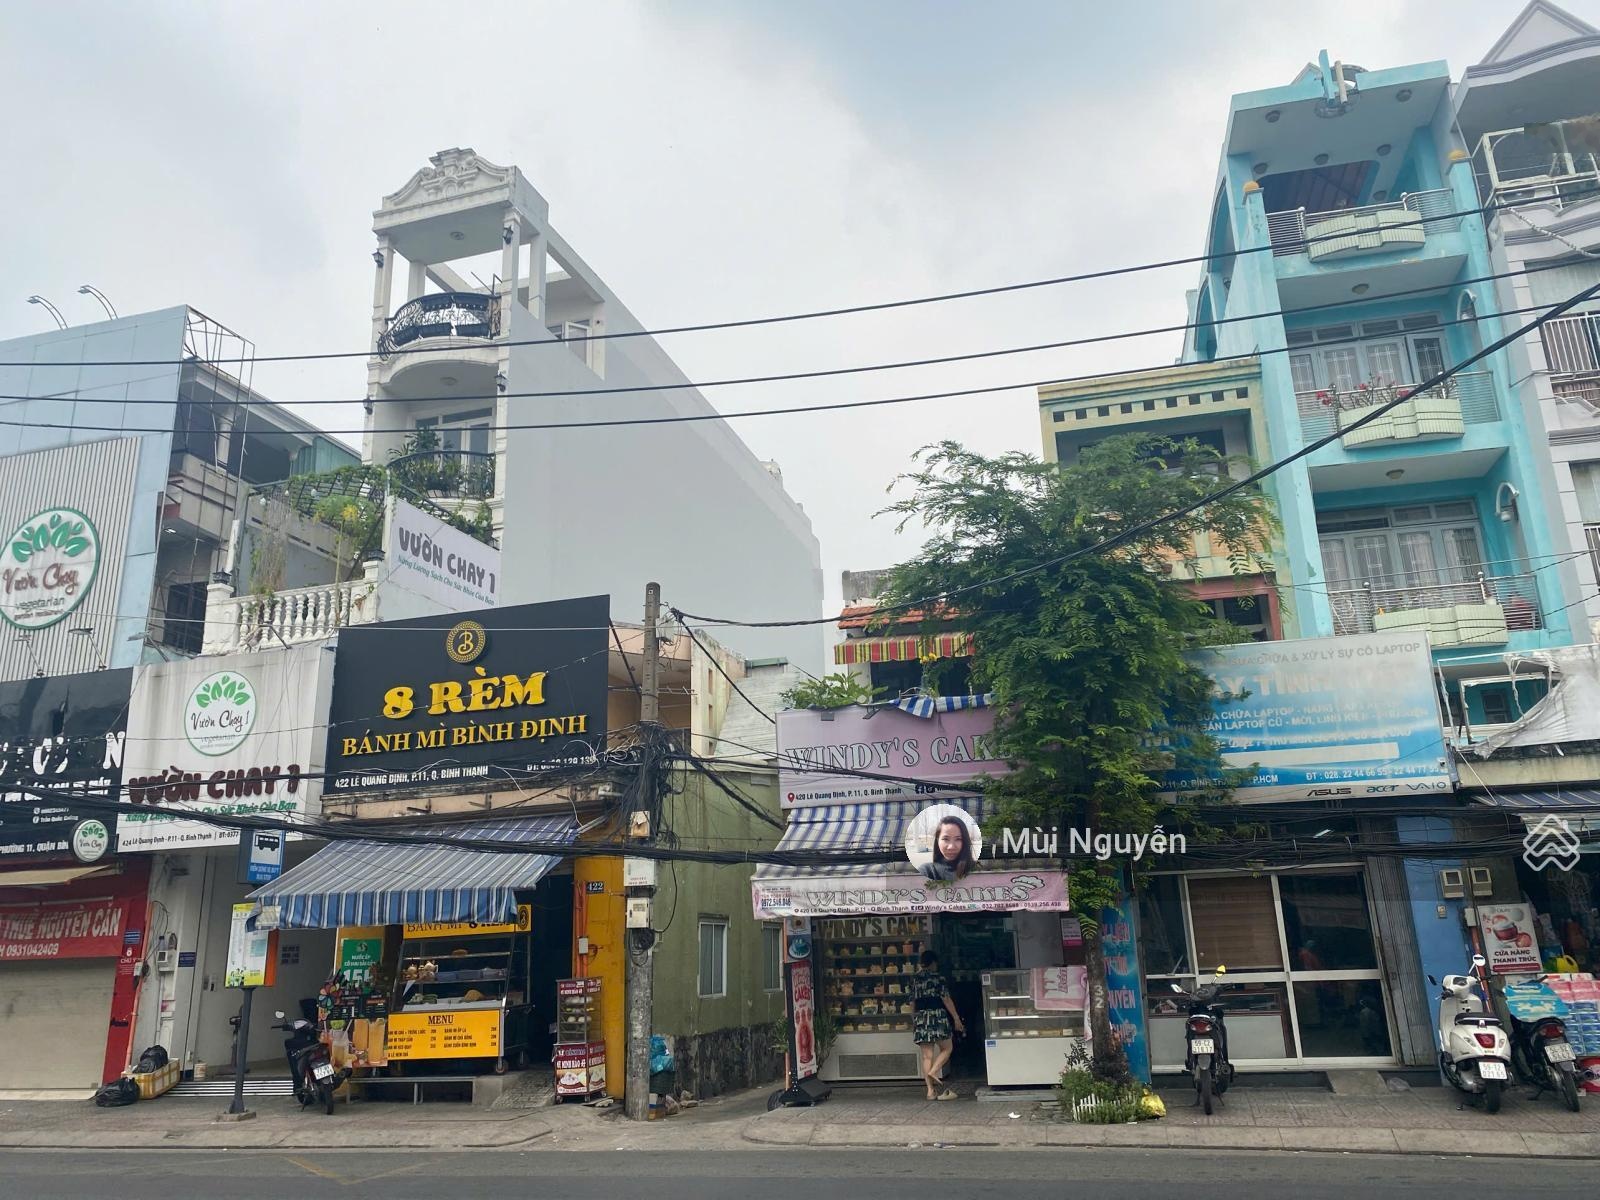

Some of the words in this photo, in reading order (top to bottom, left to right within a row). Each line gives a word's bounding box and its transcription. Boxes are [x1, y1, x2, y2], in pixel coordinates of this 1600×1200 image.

[399, 527, 442, 568] VƯỜN
[447, 554, 485, 588] CHAY
[1376, 642, 1420, 655] LAPTOP
[382, 686, 414, 719] 8
[428, 666, 546, 716] RÈM
[219, 710, 243, 732] Chay
[1226, 718, 1265, 730] LAPTOP
[342, 729, 410, 756] BÁNH
[416, 722, 446, 750] MÌ
[452, 720, 513, 747] BÌNH
[520, 714, 588, 744] ĐỊNH
[786, 737, 920, 774] WINDY'S
[930, 735, 1009, 766] CAK
[335, 777, 349, 788] 422
[350, 773, 360, 787] LÊ
[361, 772, 387, 786] QUANG
[411, 768, 430, 782] P.11,
[431, 768, 440, 782] Q.
[464, 765, 490, 779] THẠNH
[1306, 772, 1316, 781] ĐT
[1343, 769, 1352, 778] 22
[1354, 768, 1364, 778] 44
[1366, 768, 1376, 776] 66
[128, 766, 202, 804] VƯỜN
[207, 765, 281, 798] CHAY
[1307, 788, 1352, 797] ASUS
[1366, 784, 1400, 794] acer
[1406, 782, 1446, 790] VAIO
[814, 792, 832, 802] Quang
[138, 837, 152, 845] Quang
[588, 882, 604, 891] 422
[936, 886, 1030, 904] CAKES
[92, 901, 122, 937] CĂN
[886, 915, 928, 936] CAKE
[1494, 949, 1510, 957] CỬA
[1510, 948, 1530, 956] HÀNG
[428, 1014, 454, 1024] MENU
